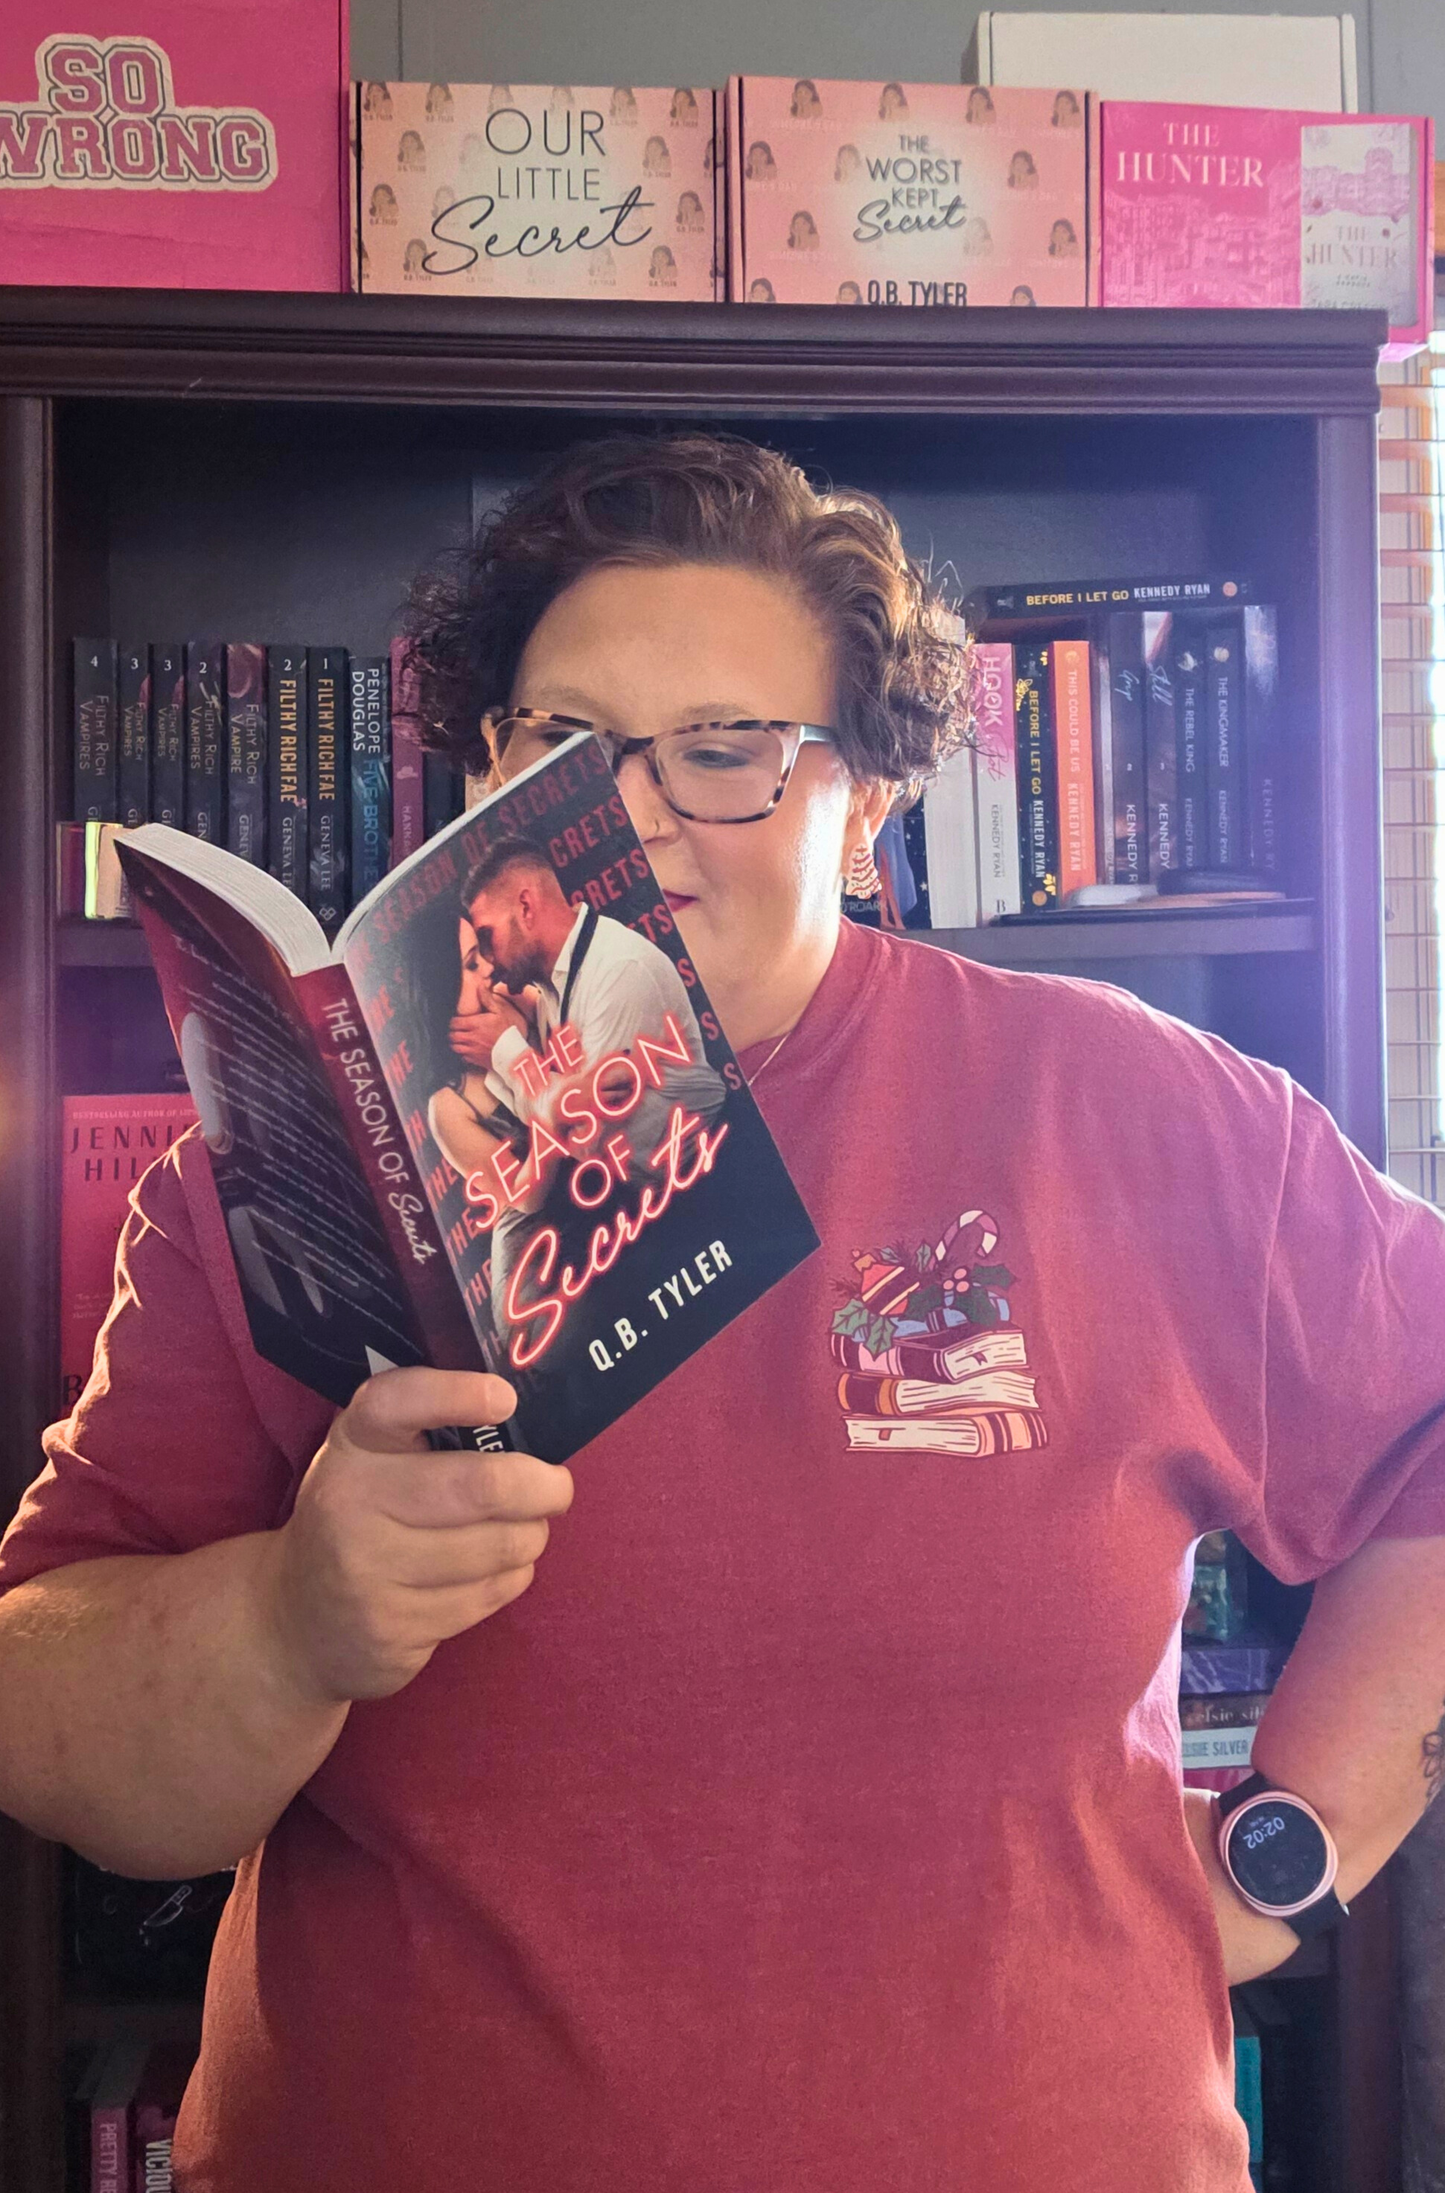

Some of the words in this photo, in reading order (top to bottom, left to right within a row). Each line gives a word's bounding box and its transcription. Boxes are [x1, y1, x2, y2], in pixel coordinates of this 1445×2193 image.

[44, 40, 167, 115] SO
[0, 112, 272, 183] WRONG
[485, 108, 606, 156] OUR
[898, 134, 930, 155] THE
[1163, 121, 1221, 150] THE
[498, 166, 600, 201] LITTLE
[866, 157, 962, 184] WORST
[1117, 151, 1264, 190] HUNTER
[892, 187, 938, 209] KEPT
[422, 185, 656, 276] Secret
[853, 194, 967, 243] Secret
[908, 281, 967, 307] TYLER
[1026, 593, 1074, 606] BEFORE
[1077, 593, 1082, 603] I
[1086, 591, 1108, 603] LET
[1112, 590, 1129, 601] GO
[1133, 584, 1181, 599] KENNEDY
[1184, 583, 1211, 596] RYAN
[90, 655, 99, 668] 4
[131, 658, 139, 670] 3
[164, 660, 172, 671] 3
[200, 662, 208, 674] 2
[283, 658, 292, 672] 2
[322, 657, 329, 669] 1
[981, 655, 1003, 727] HOOK
[1068, 670, 1079, 695] THIS
[1150, 665, 1174, 707] Still
[1185, 687, 1195, 707] THE
[1218, 676, 1229, 697] THE
[280, 679, 297, 732] FILTHY
[318, 678, 335, 731] FILTHY
[351, 671, 366, 752] DOUGLAS
[367, 668, 381, 754] PENELOPE
[1029, 690, 1040, 738] BEFORE
[1068, 698, 1080, 737] COULD
[79, 700, 94, 771] VAMPIRES
[190, 705, 203, 770] VAMPIRES
[230, 714, 243, 774] VAMPIRE
[1185, 709, 1195, 742] REBEL
[1218, 699, 1230, 768] KINGMAKER
[95, 742, 110, 777] RICH
[204, 744, 217, 776] RICH
[280, 735, 297, 773] RICH
[318, 734, 335, 772] RICH
[1031, 750, 1042, 774] LET
[1070, 739, 1081, 756] BE
[1071, 758, 1081, 773] US
[1185, 743, 1196, 773] KING
[246, 751, 260, 785] RICH
[319, 774, 336, 801] FAE
[363, 758, 379, 799] FIVE
[1031, 778, 1042, 796] GO
[280, 776, 298, 803] FAE
[991, 803, 1002, 852] KENNEDY
[1032, 799, 1045, 849] KENNEDY
[1068, 782, 1081, 837] KENNEDY
[1184, 797, 1193, 842] KENNEDY
[1218, 789, 1228, 835] KENNEDY
[239, 814, 250, 857] GENEV
[282, 816, 294, 868] GENEVA
[320, 815, 331, 867] GENEVA
[1126, 804, 1139, 871] KENNEDY
[1158, 803, 1172, 869] KENNEDY
[1219, 837, 1229, 864] RYAN
[993, 854, 1003, 879] RYAN
[1034, 851, 1046, 879] RYAN
[1070, 840, 1082, 872] RYAN
[321, 869, 331, 891] LEE
[321, 997, 359, 1043] THE
[512, 1025, 585, 1099] THE
[340, 1048, 395, 1148] SEASON
[464, 1013, 693, 1230] SEASON
[379, 1152, 410, 1185] OF
[570, 1134, 635, 1208] OF
[387, 1191, 438, 1265] Secrets
[507, 1106, 730, 1367] Secrets
[588, 1318, 648, 1372] Q.B.
[648, 1239, 733, 1320] TYLER
[1212, 1739, 1248, 1756] SILVER
[1242, 1814, 1287, 1851] 02:02
[99, 2122, 118, 2176] PRETTY
[145, 2138, 172, 2193] VICIOU
